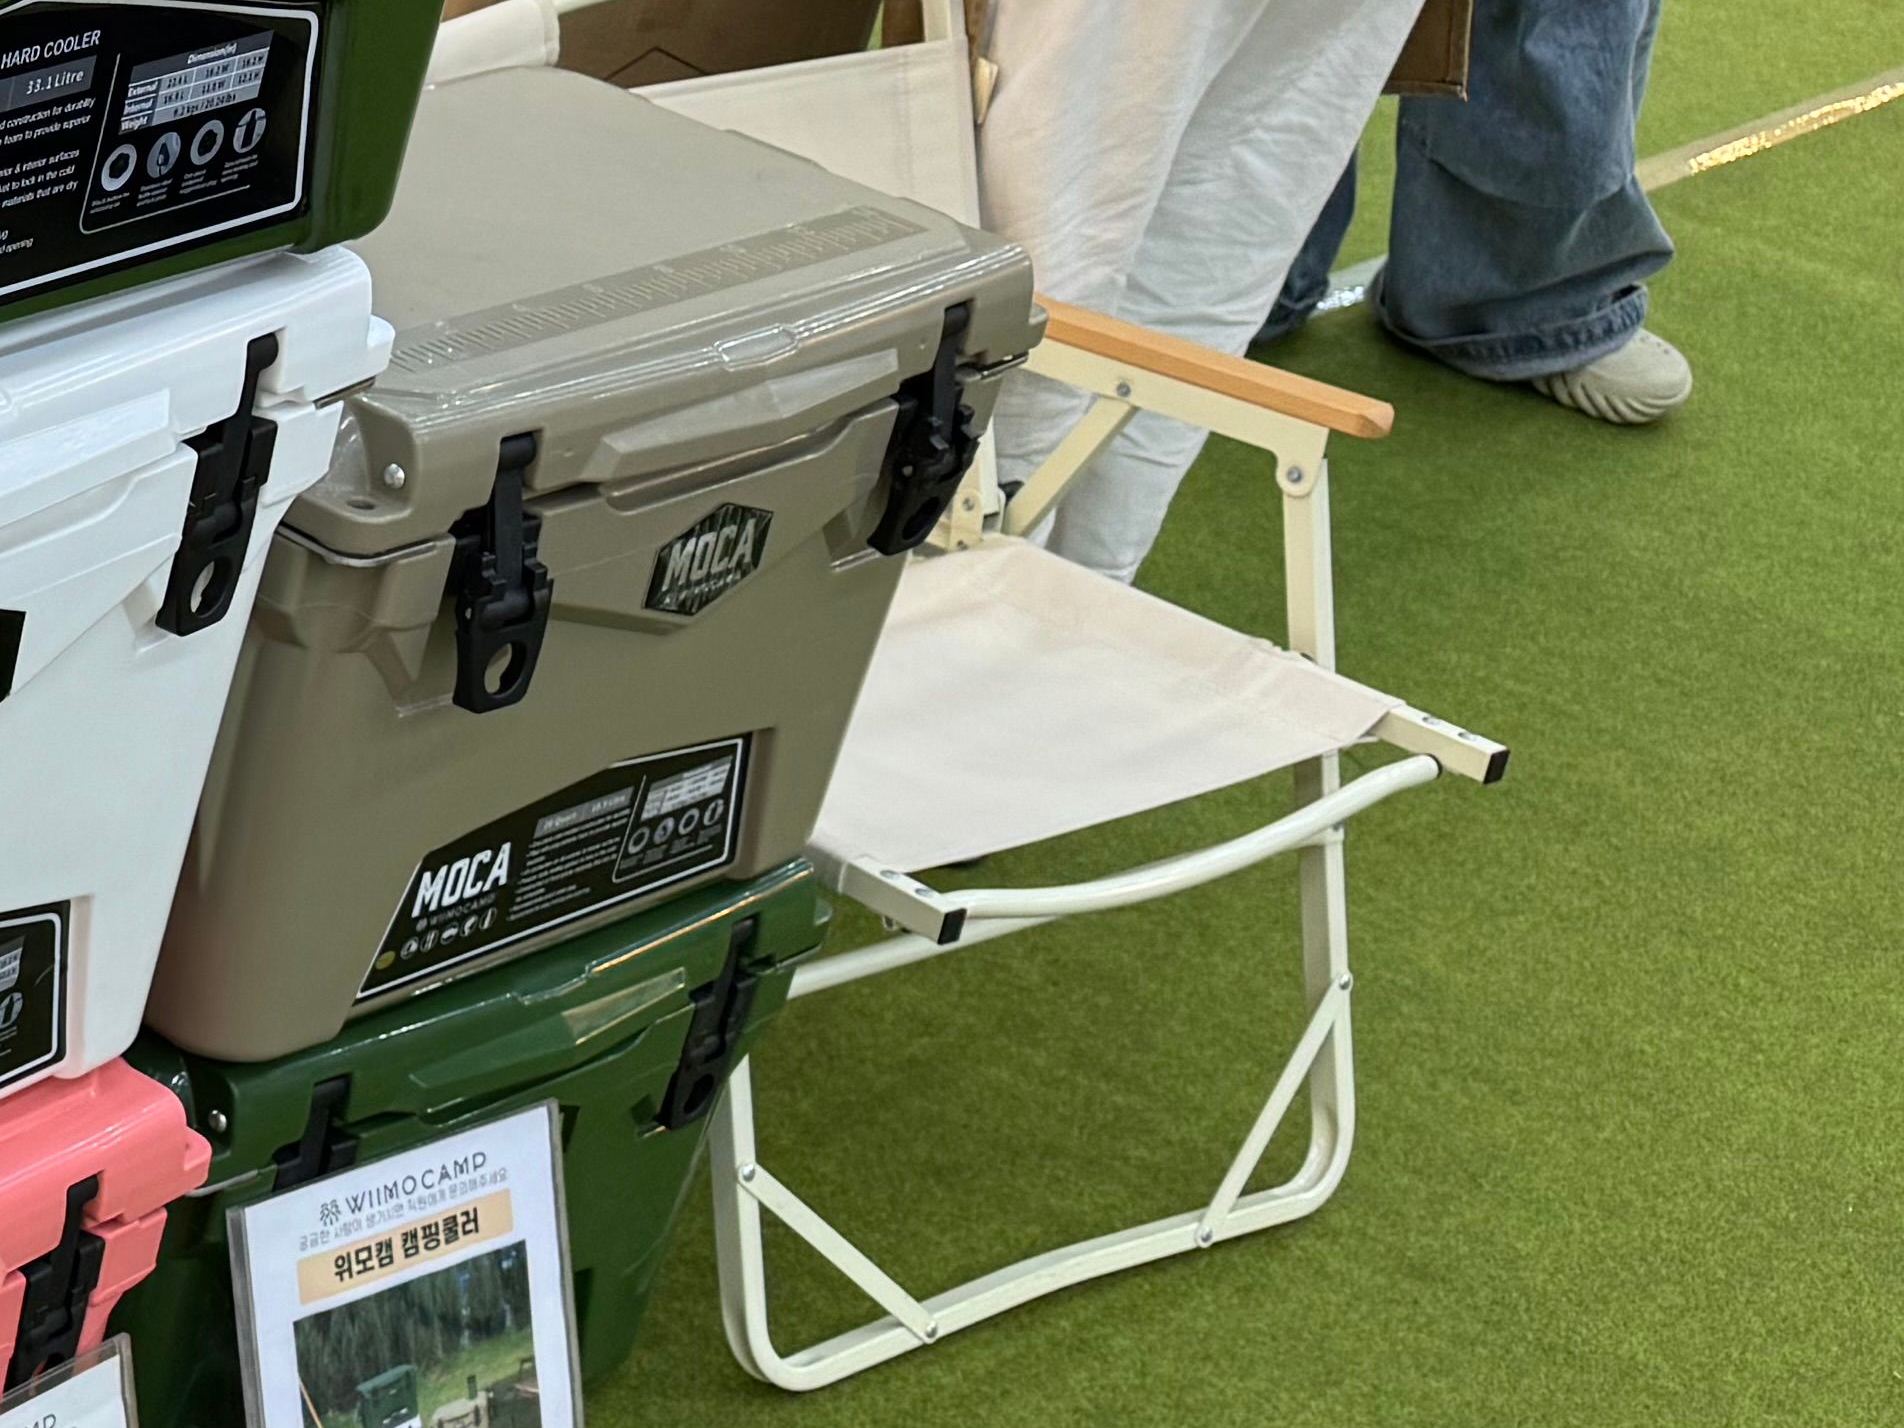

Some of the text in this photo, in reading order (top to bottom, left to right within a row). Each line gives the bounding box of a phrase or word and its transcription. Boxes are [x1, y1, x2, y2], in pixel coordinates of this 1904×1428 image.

[1, 45, 41, 70] HARD
[43, 29, 101, 58] COOLER
[26, 76, 52, 95] 33.1
[54, 71, 84, 87] Litre
[662, 517, 757, 592] MOCA
[411, 841, 512, 918] MOCA
[345, 1151, 487, 1215] WIIMOCAMP
[334, 1207, 480, 1282] 위모캠 캠핑쿨러
